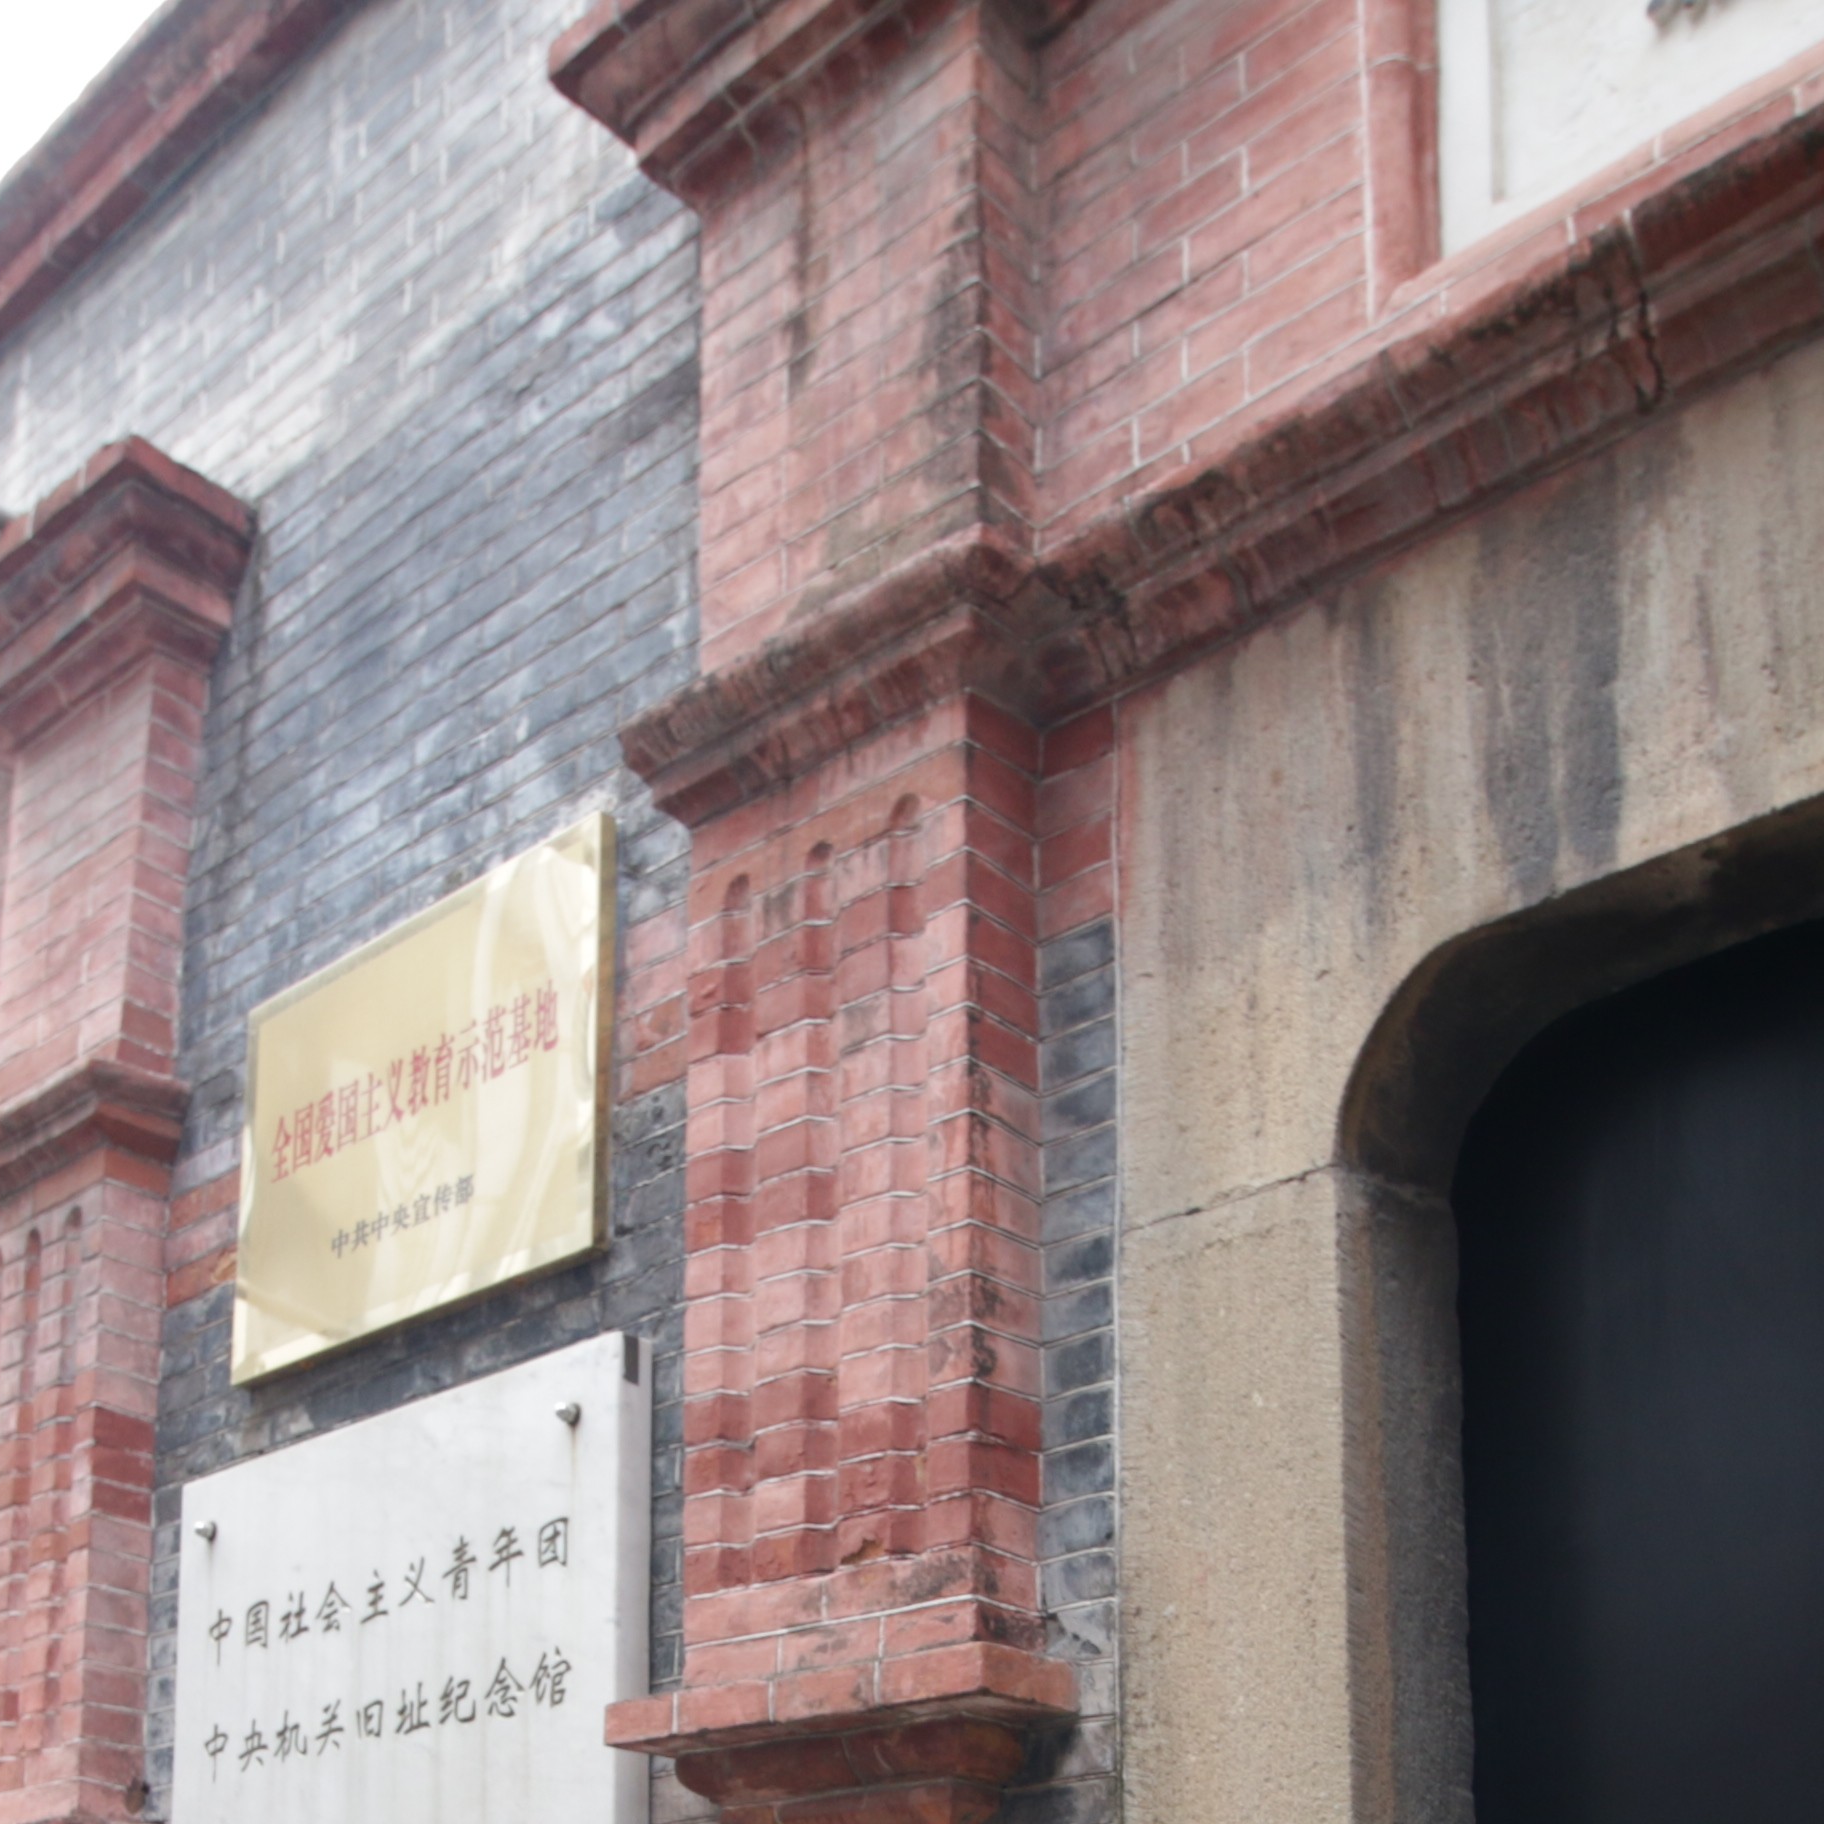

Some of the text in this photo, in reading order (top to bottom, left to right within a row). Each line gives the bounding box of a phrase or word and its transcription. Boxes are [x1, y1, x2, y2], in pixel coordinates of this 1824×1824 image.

[270, 979, 559, 1184] 全国爱国主义教育示范基地
[330, 1173, 475, 1259] 中共中央宣传部
[208, 1516, 570, 1667] 中国社会主义青年团
[203, 1646, 572, 1783] 中央机关旧址纪念馆
